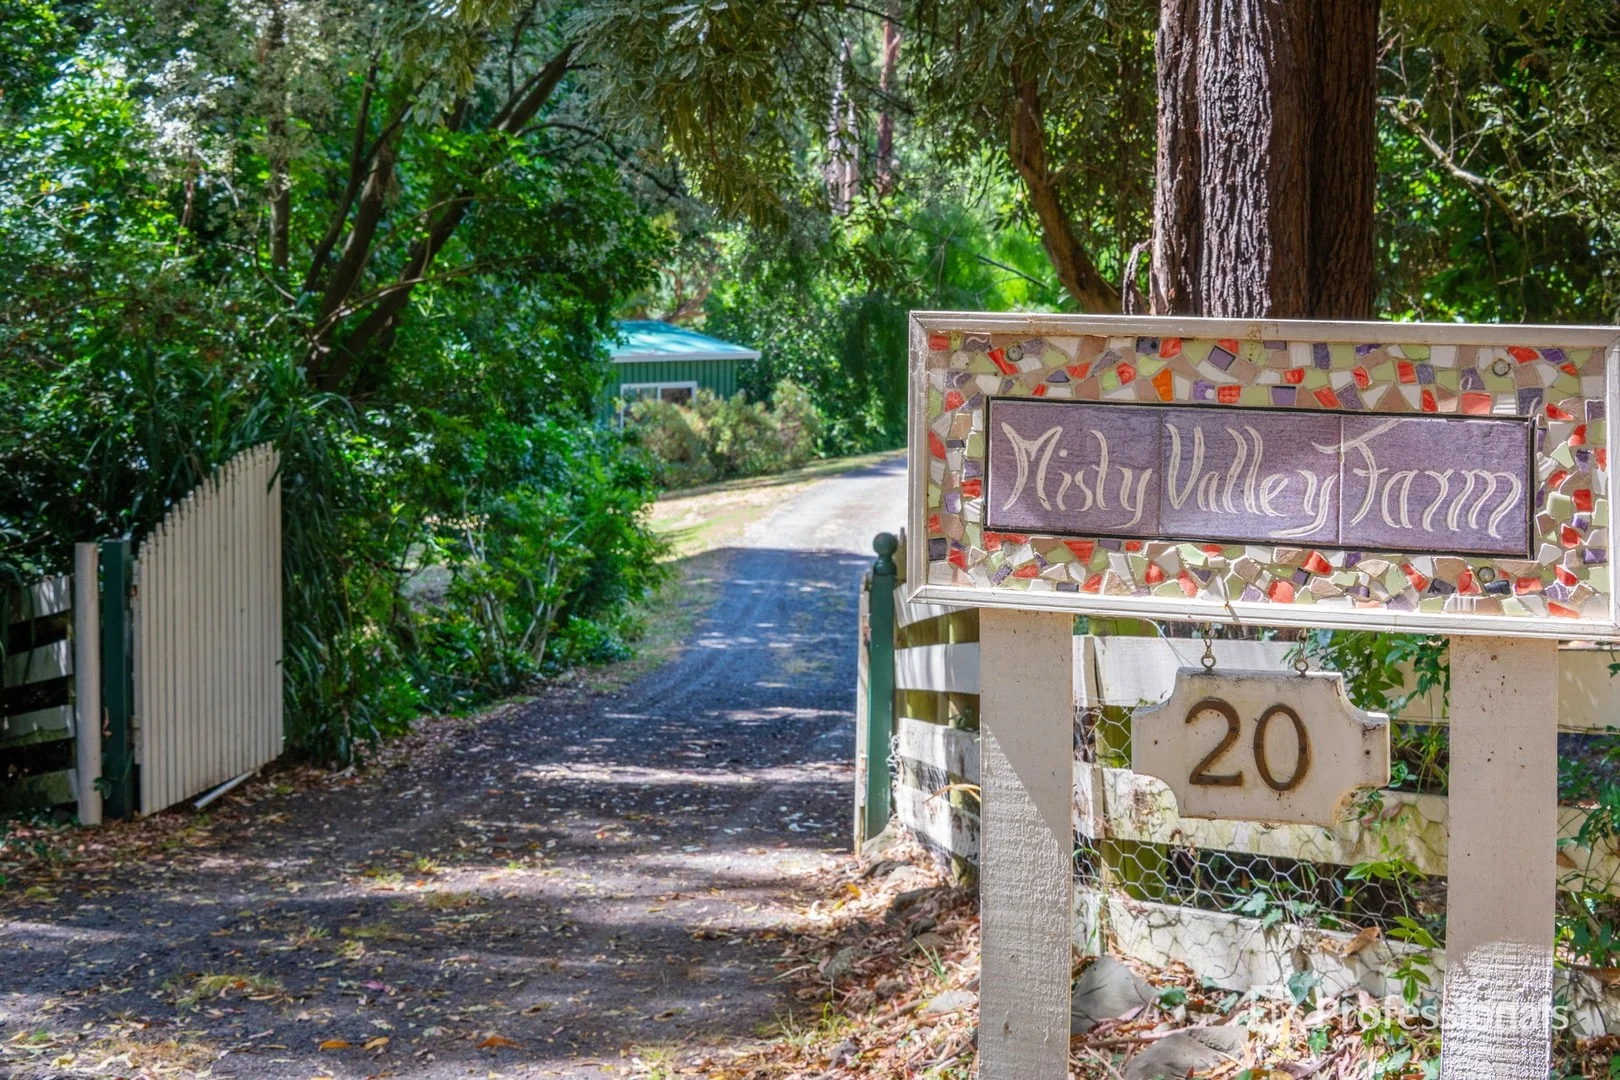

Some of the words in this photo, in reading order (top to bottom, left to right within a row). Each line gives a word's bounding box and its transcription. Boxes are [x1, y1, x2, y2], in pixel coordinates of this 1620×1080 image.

[1000, 420, 1153, 529] Misty
[1164, 422, 1338, 538] Valley
[1311, 418, 1523, 539] Farm
[1184, 697, 1310, 792] 20
